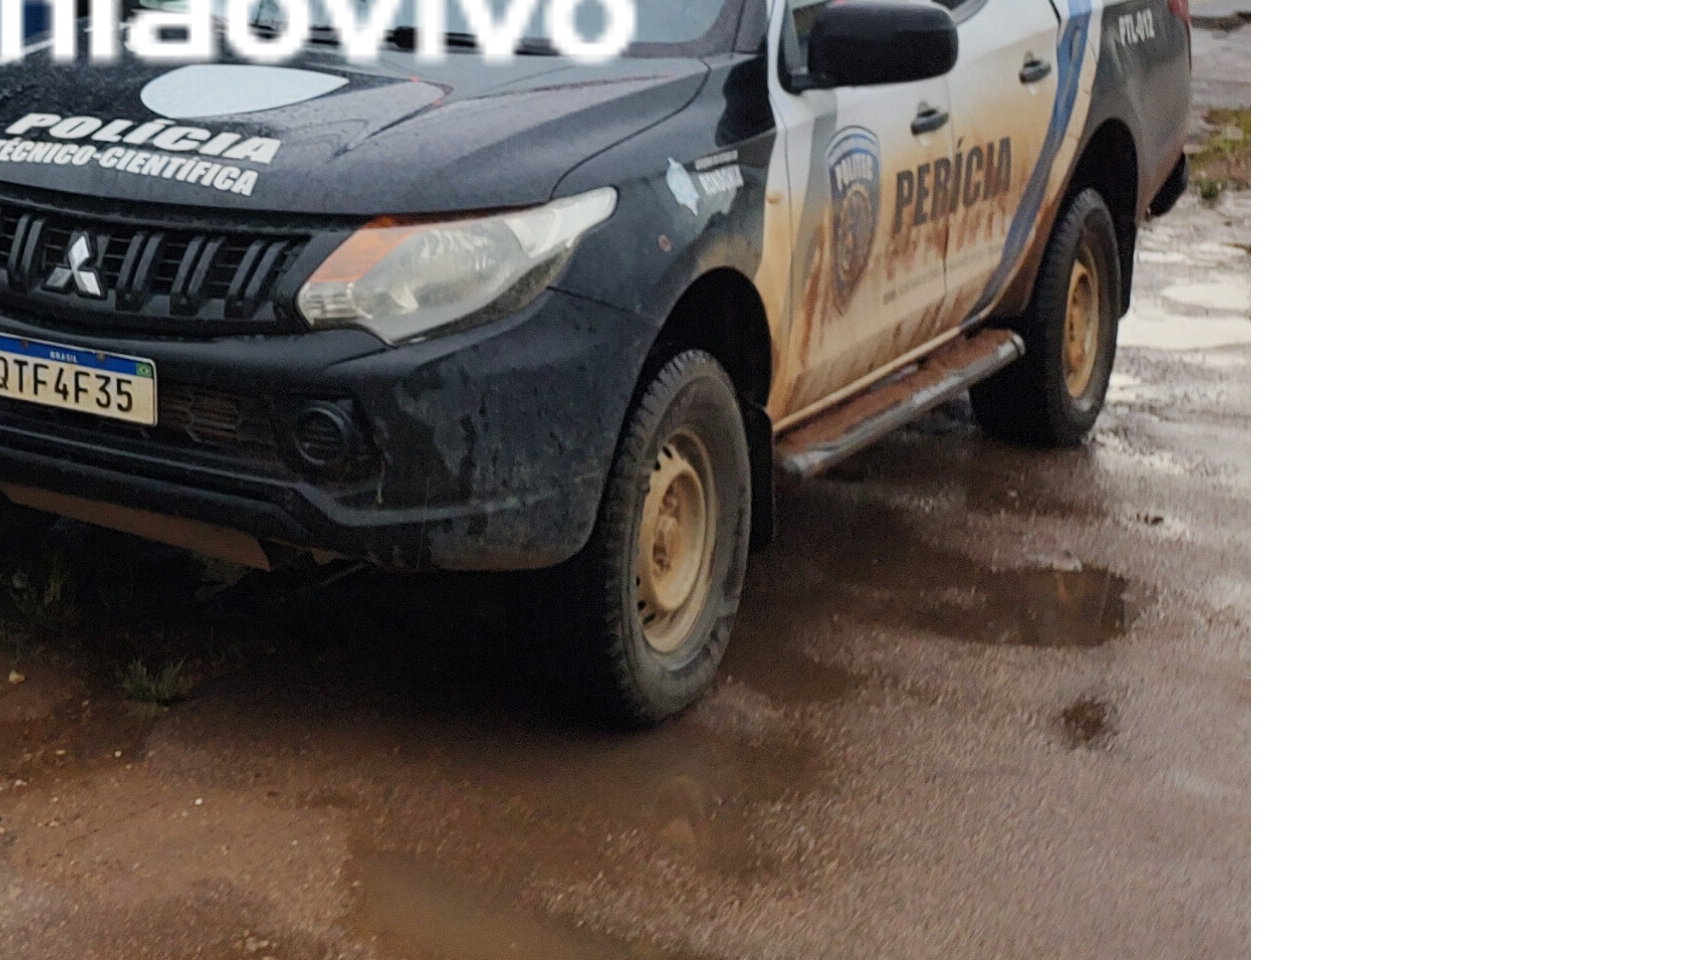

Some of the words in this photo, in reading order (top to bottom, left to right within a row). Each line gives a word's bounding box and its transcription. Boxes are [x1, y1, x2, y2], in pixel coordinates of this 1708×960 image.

[5, 112, 282, 165] POLÍCIA
[892, 136, 1012, 235] PERÍCIA
[49, 350, 78, 364] BRASIL
